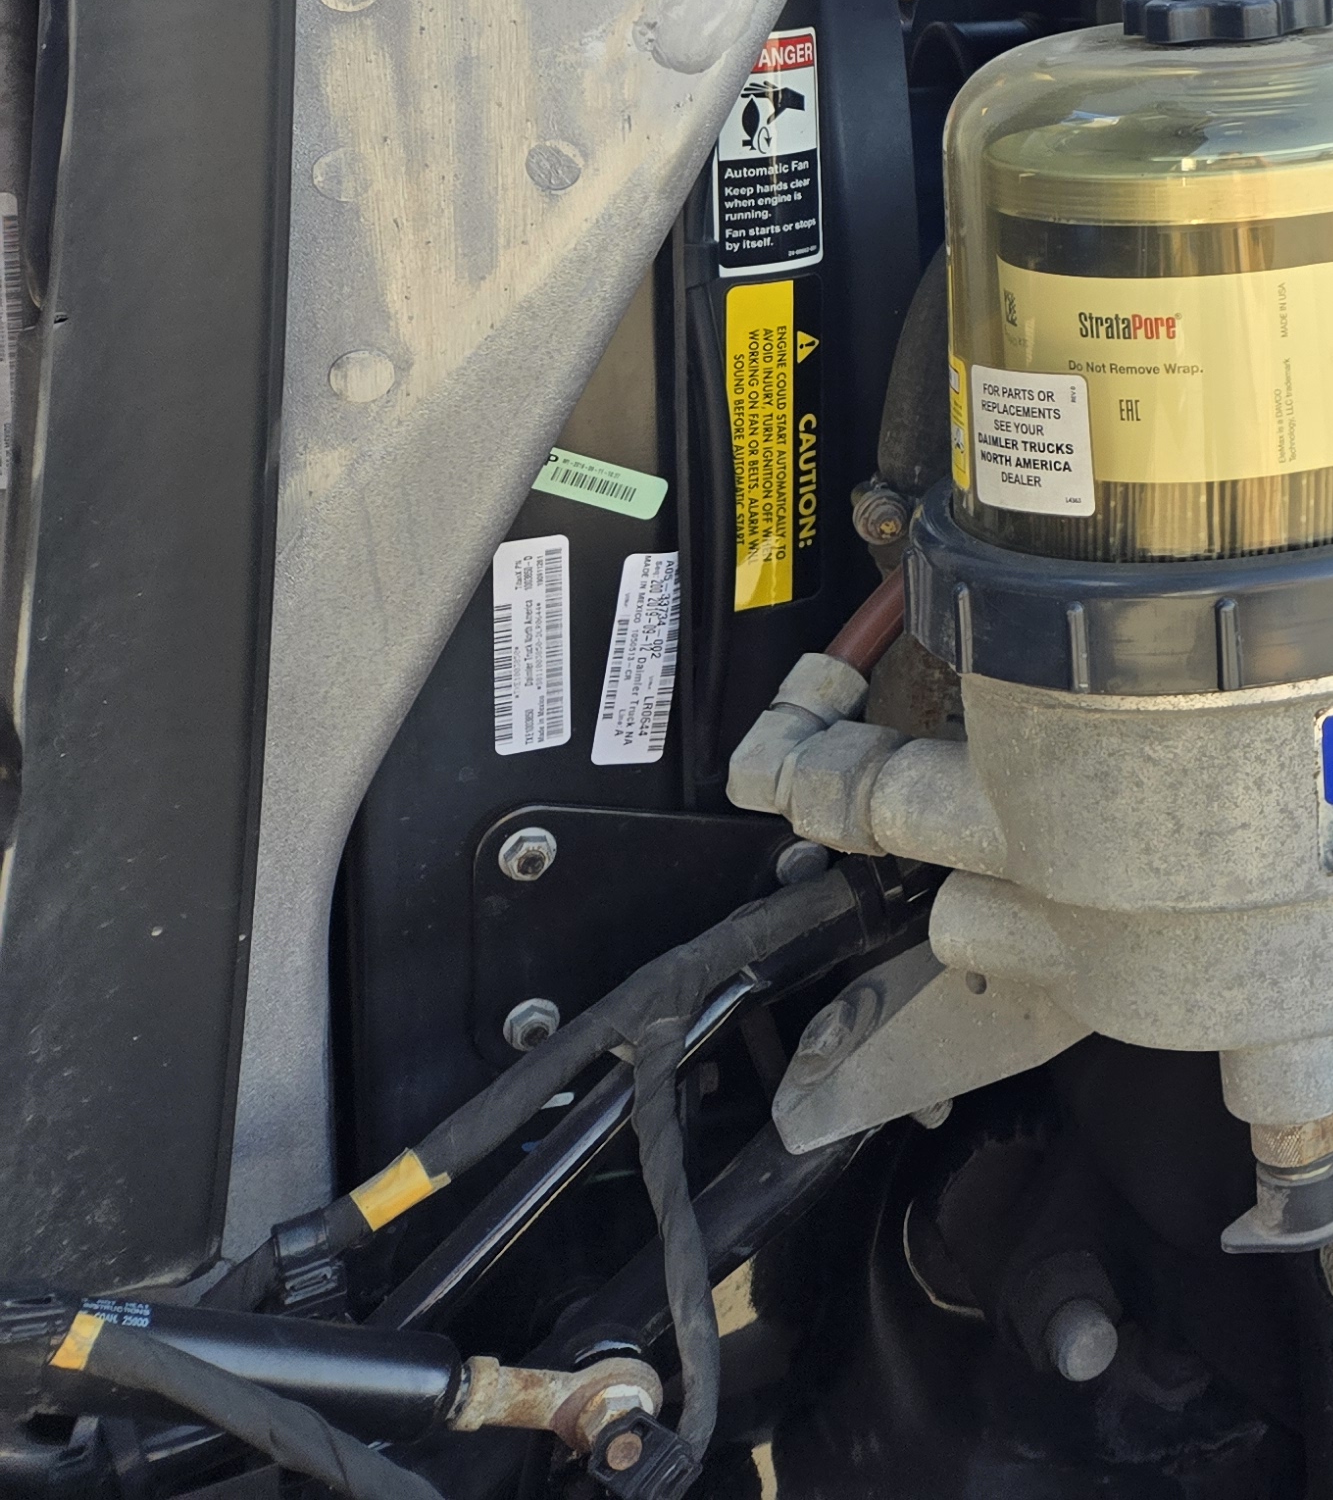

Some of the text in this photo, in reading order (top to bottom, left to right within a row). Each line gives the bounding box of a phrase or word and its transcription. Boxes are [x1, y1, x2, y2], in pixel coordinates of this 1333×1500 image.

[724, 160, 809, 179] Automatic Fan
[725, 177, 811, 197] Keep hands clear
[724, 191, 803, 209] when engine is
[725, 209, 772, 222] running.
[725, 218, 817, 239] Fan starts or stops
[725, 237, 774, 253] by itself.
[1278, 282, 1289, 338] MADE IN USA
[1068, 360, 1205, 376] Do Not Remove Wrap.
[982, 382, 1056, 403] FOR PARTS OR
[981, 399, 1062, 420] REPLACEMENTS
[747, 328, 760, 537] WORKING ON FAN OR BELTS. ALARM
[993, 419, 1044, 436] SEE YOUR
[733, 353, 745, 546] SOUND BEFORE AUTOMATIC START
[761, 327, 774, 563] AVOID INJURY, TURN IGNITION OFF WHEN
[775, 325, 787, 561] ENGINE COULD START TO
[978, 432, 1075, 456] DAIMLER TRUCKS
[980, 449, 1073, 473] NORTH AMERICA
[798, 413, 818, 549] CAUTION:
[1001, 470, 1042, 488] DEALER
[641, 555, 652, 579] MADE
[633, 591, 645, 624] MEXICO
[623, 657, 647, 746] Daimler Truck NA
[638, 695, 655, 737] LR0644
